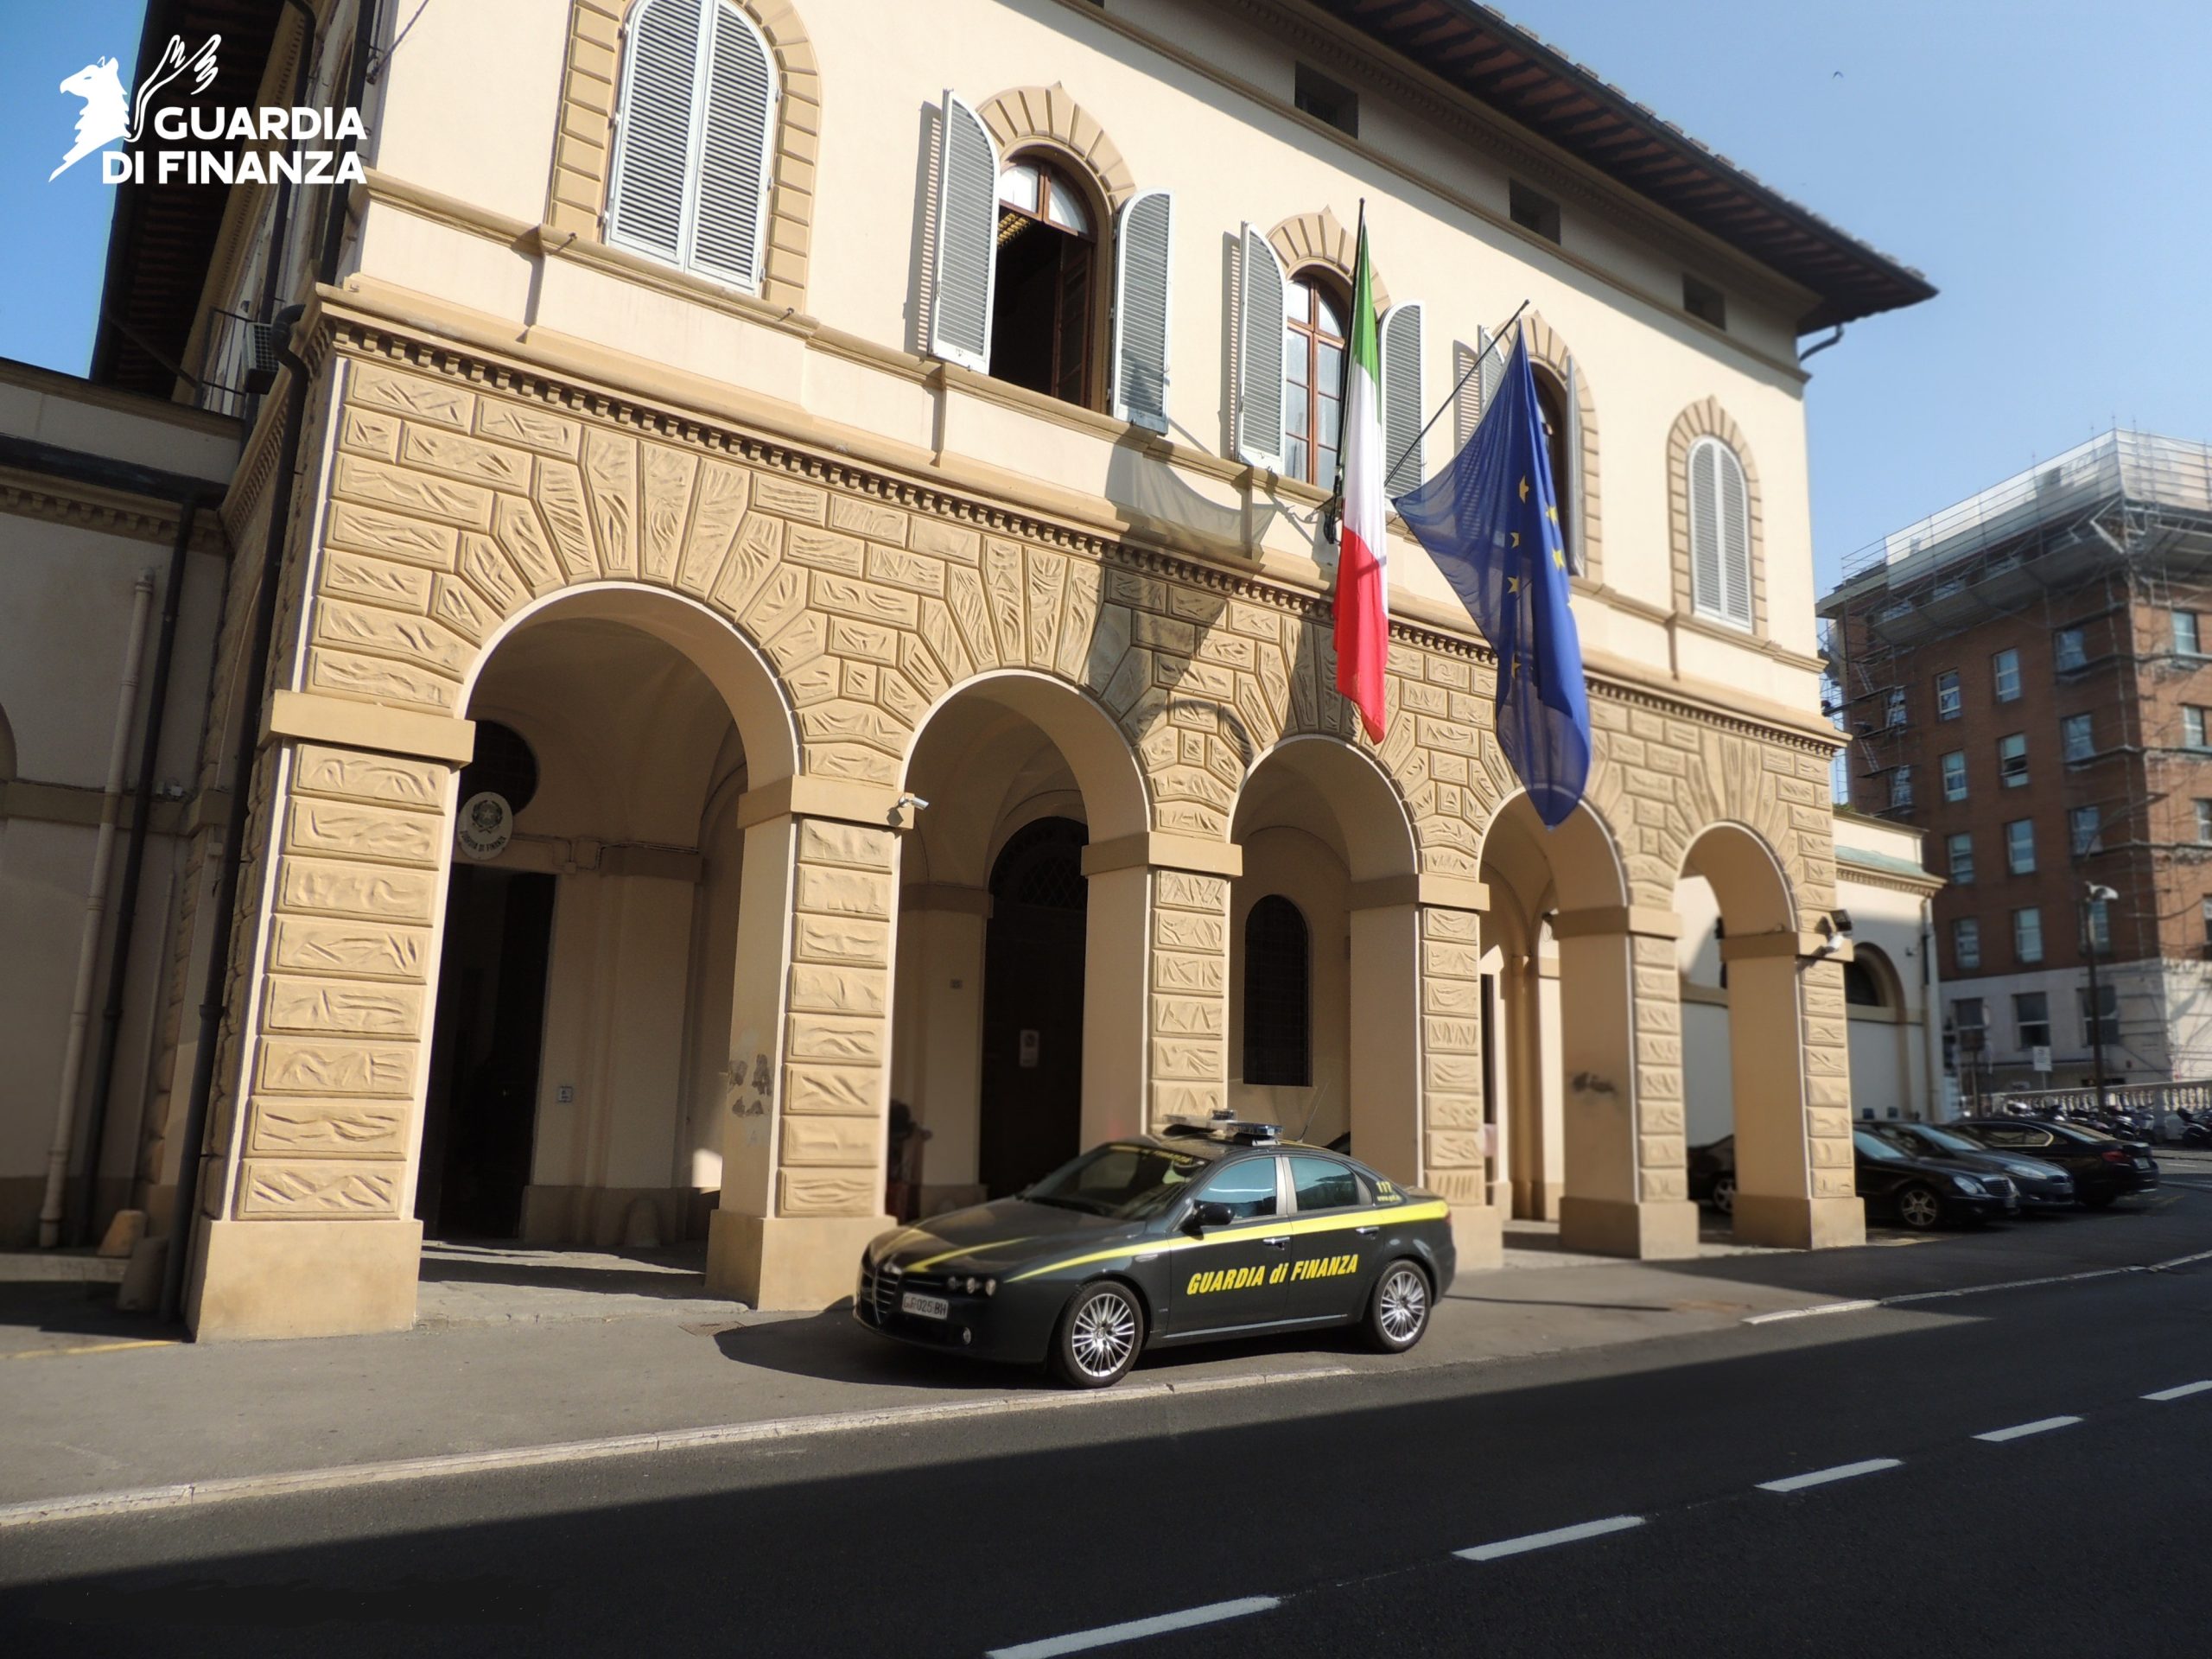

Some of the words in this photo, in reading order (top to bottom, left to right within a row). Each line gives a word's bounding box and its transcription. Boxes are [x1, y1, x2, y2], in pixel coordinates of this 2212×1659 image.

[1376, 1180, 1392, 1193] 117
[1186, 1265, 1266, 1295] GUARDIA
[1268, 1262, 1290, 1284] di
[1290, 1254, 1359, 1281] FINANZA
